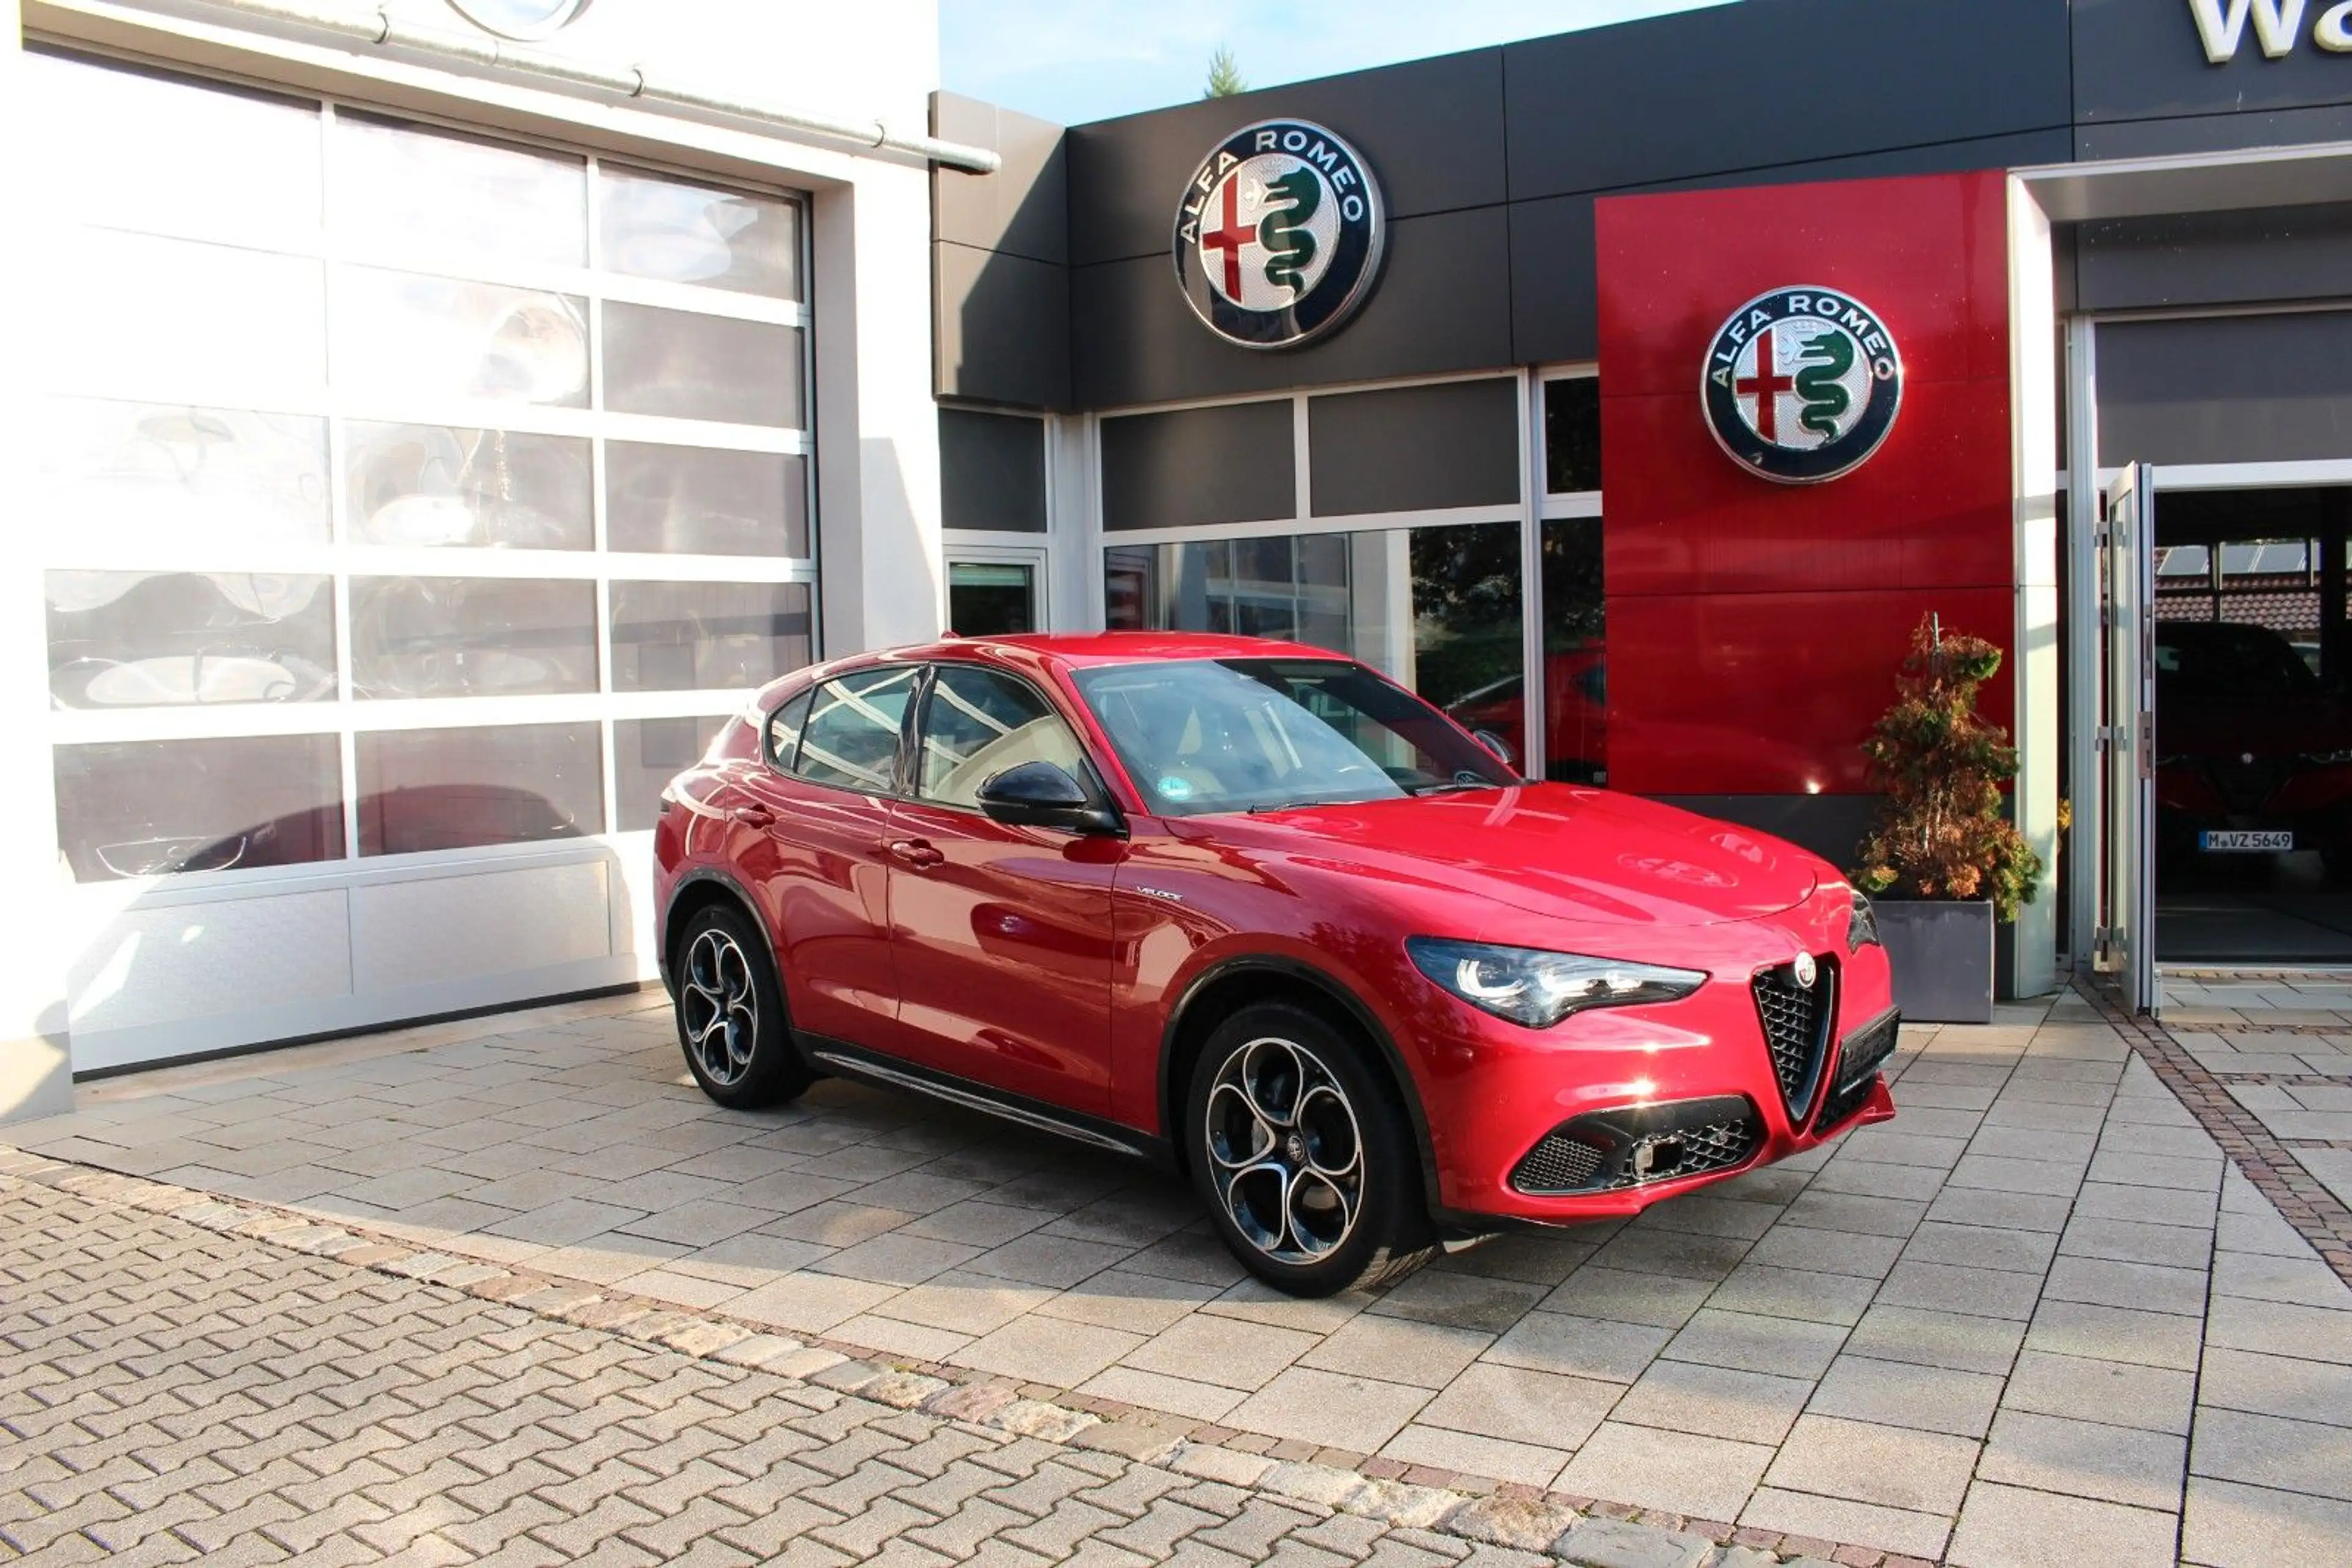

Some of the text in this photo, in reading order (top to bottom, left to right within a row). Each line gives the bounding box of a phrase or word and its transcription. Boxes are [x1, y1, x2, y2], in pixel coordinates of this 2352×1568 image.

[1180, 130, 1364, 244] ALFA ROMEO
[1712, 295, 1894, 388] ALFA ROMEO
[2208, 833, 2290, 847] M VZ 5649
